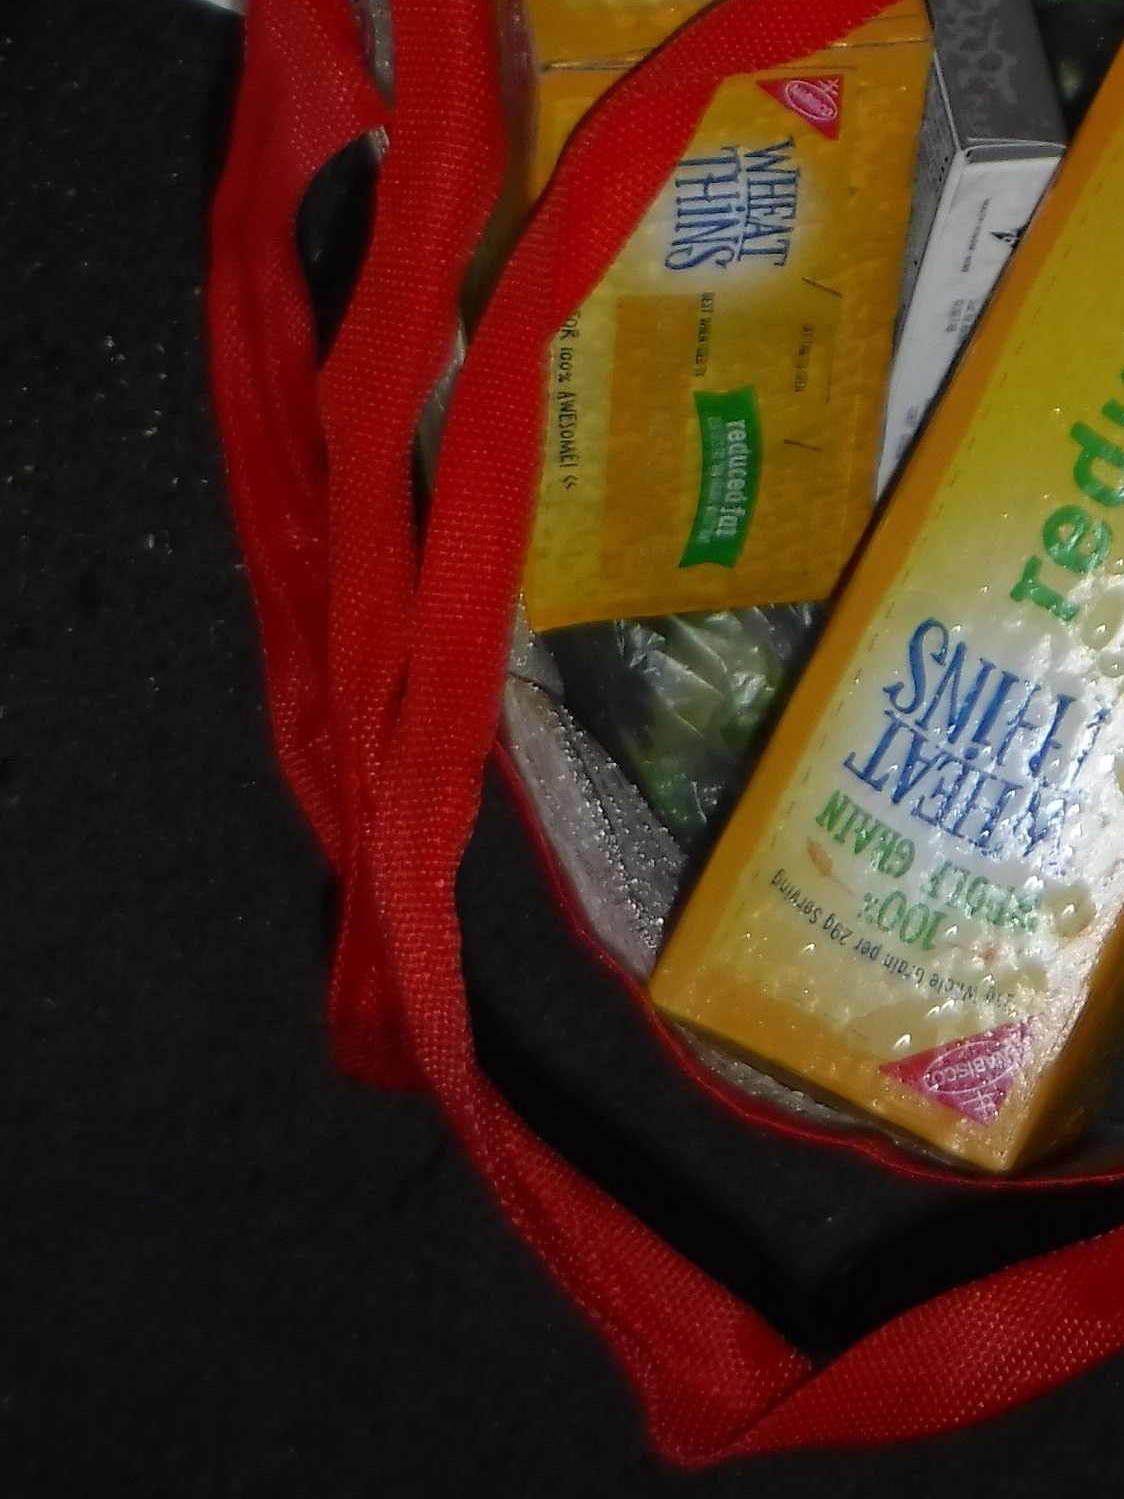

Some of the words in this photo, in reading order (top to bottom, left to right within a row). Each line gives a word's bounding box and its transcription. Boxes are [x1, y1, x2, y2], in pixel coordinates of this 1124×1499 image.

[739, 135, 801, 268] WHEAT
[558, 347, 573, 382] 100%
[558, 391, 580, 467] AWESOME!
[724, 419, 752, 502] reduced
[715, 506, 745, 537] fat
[813, 788, 917, 881] GRAIN
[770, 869, 823, 925] Serving
[859, 889, 947, 951] 100%
[823, 914, 847, 947] 29g
[853, 937, 878, 964] per
